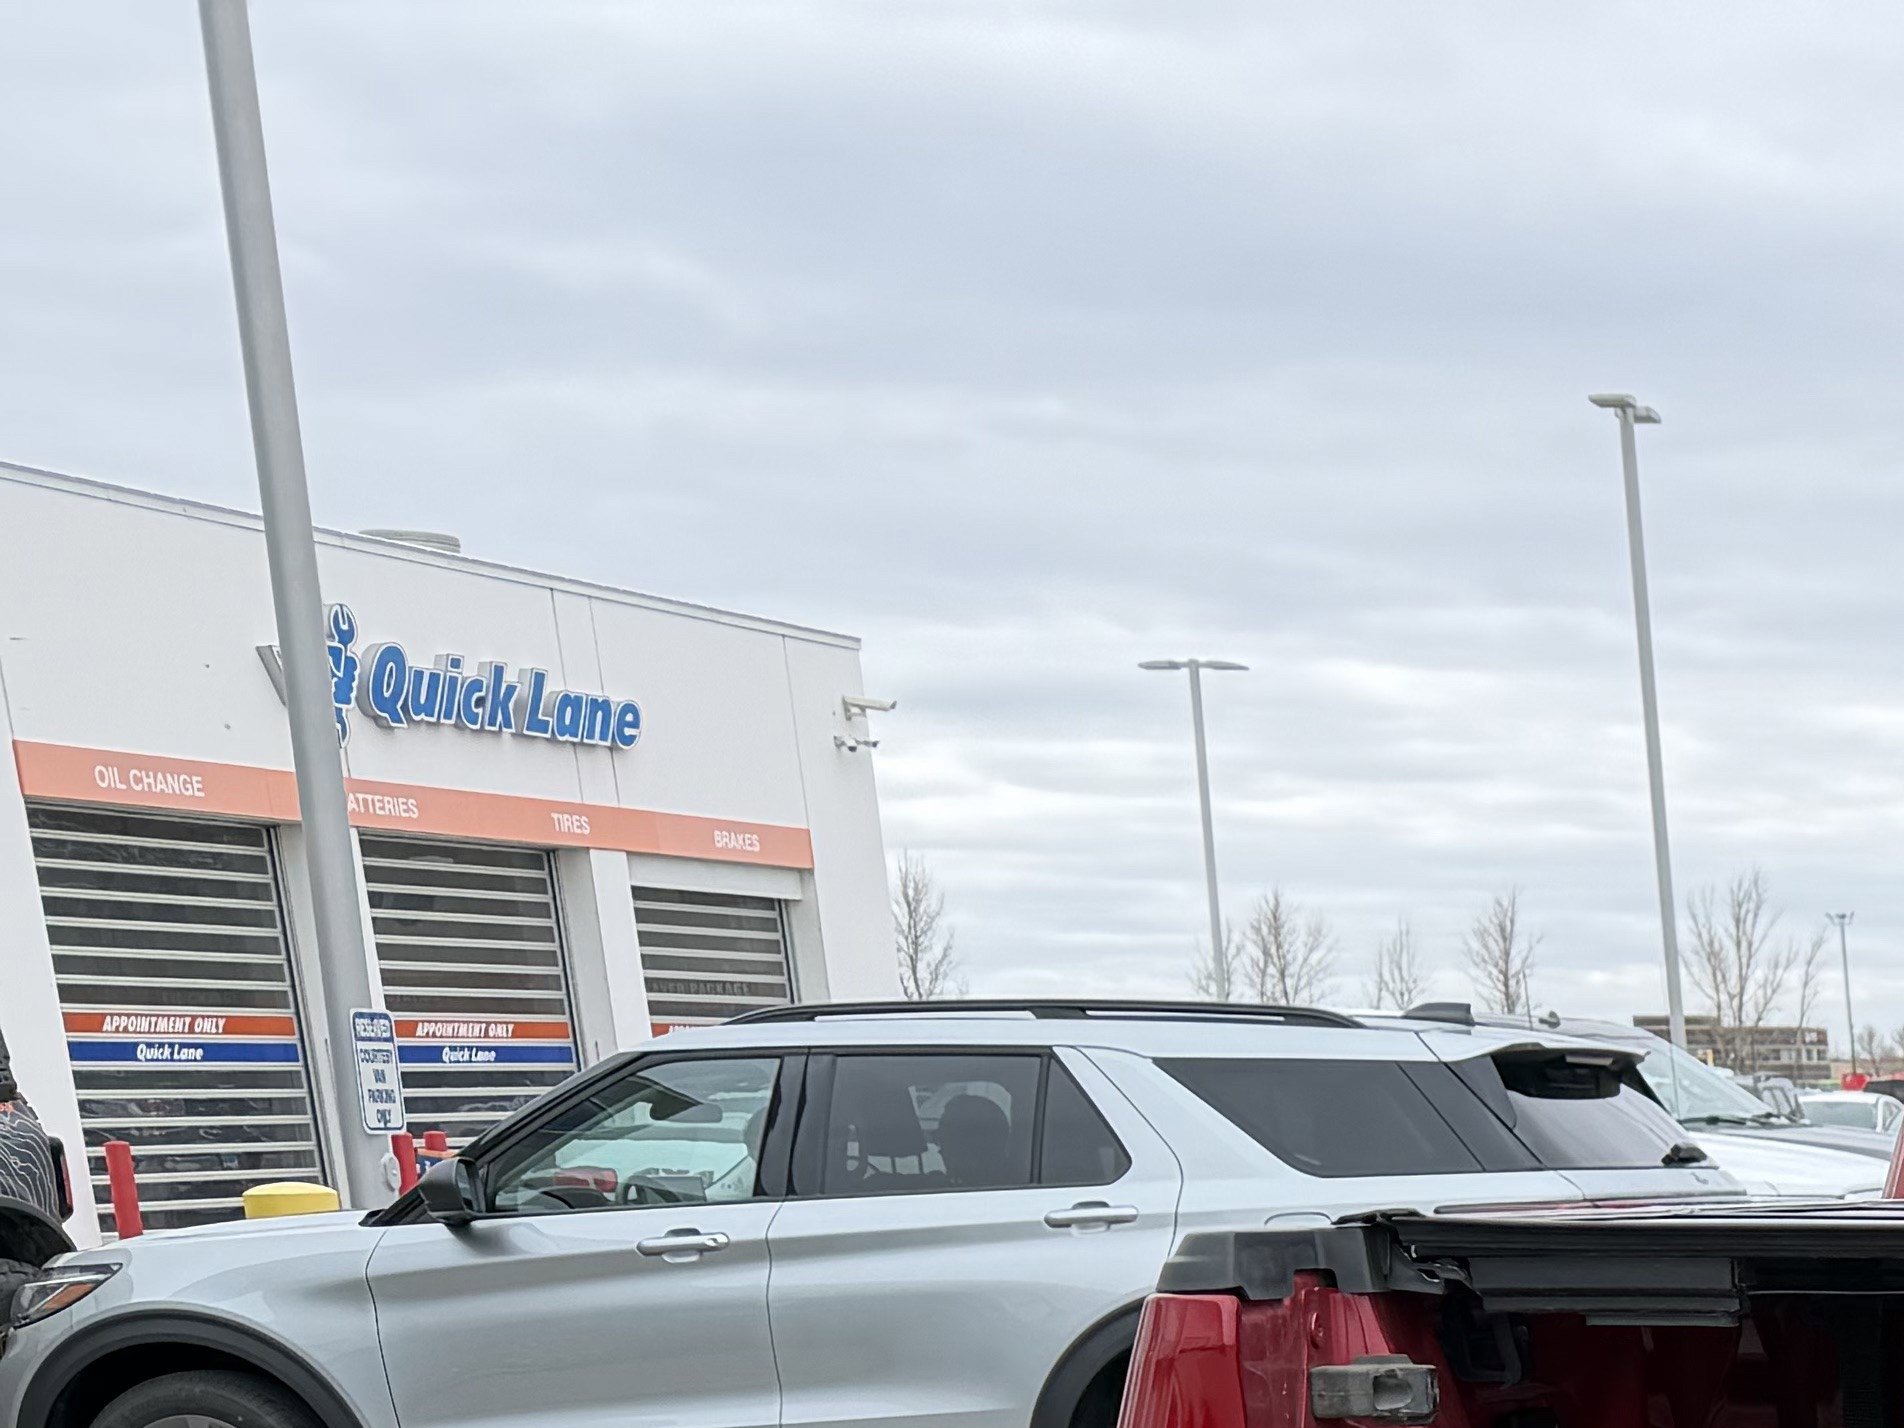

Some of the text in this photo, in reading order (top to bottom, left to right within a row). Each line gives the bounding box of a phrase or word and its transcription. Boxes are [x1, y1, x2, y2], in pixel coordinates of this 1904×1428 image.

[369, 642, 642, 750] Quick Lane
[94, 765, 205, 798] OIL CHANGE
[346, 792, 419, 819] ATTERIES
[551, 812, 591, 835] TIRES
[713, 829, 760, 852] BRAKES
[102, 1015, 226, 1034] APPOINTMENT ONLY
[416, 1022, 515, 1037] APPOINTMENT ONLY
[136, 1043, 204, 1062] Quick Lane
[442, 1046, 471, 1063] Quick
